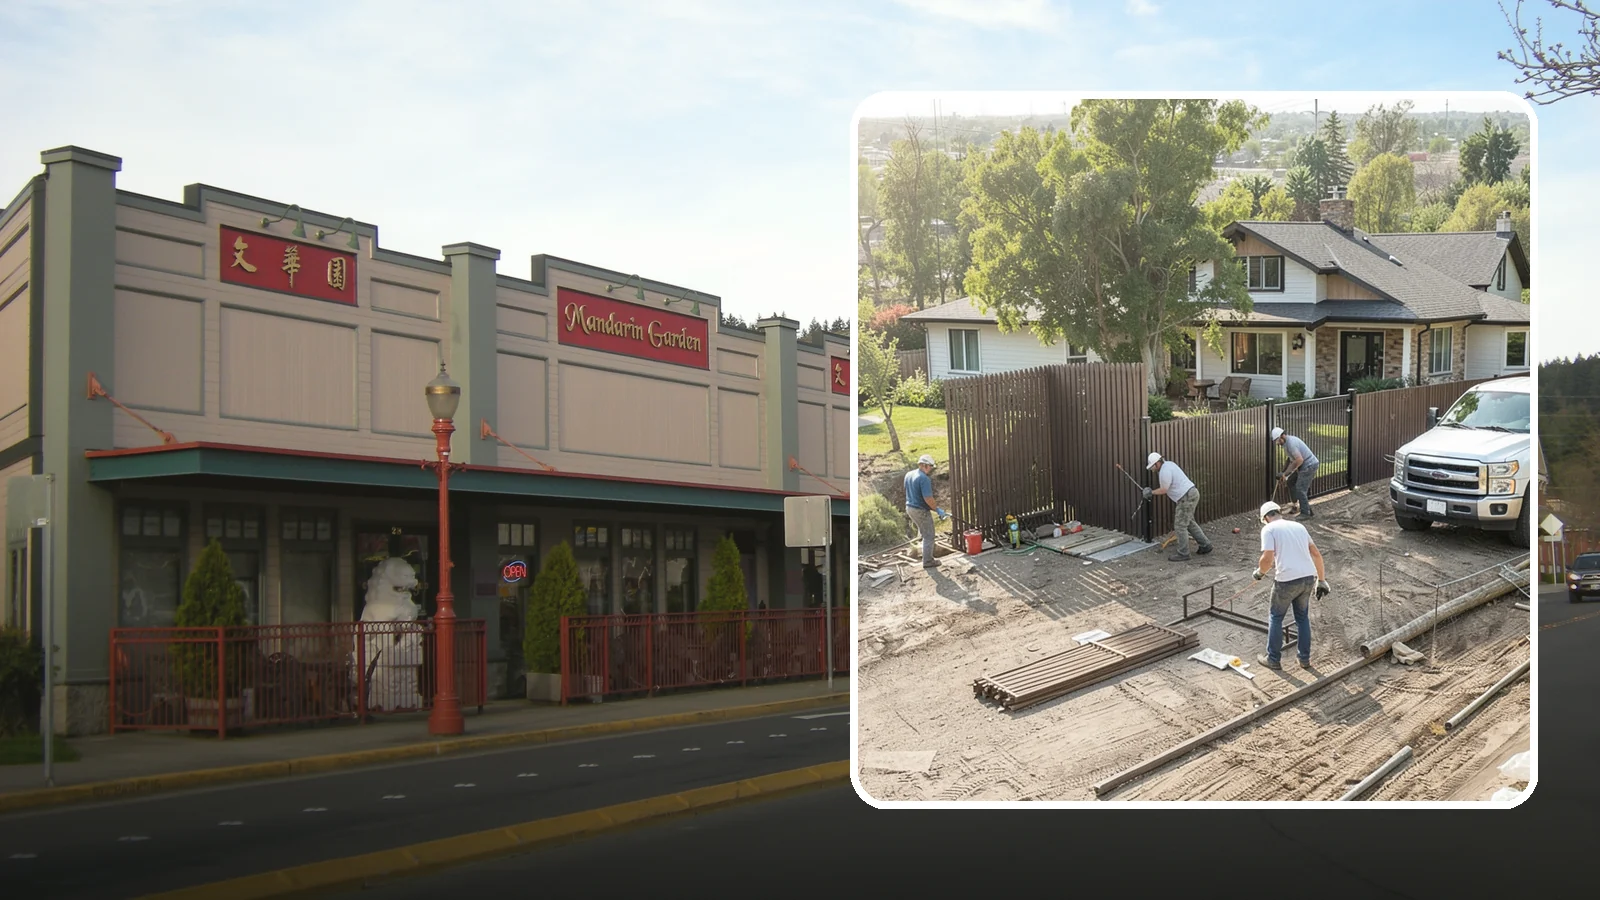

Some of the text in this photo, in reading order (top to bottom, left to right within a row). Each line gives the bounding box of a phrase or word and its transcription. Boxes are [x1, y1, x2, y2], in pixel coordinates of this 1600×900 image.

[230, 235, 347, 291] 文華園
[564, 302, 701, 352] Mandarin Garden
[835, 363, 846, 386] 文
[503, 565, 527, 578] OPEN
